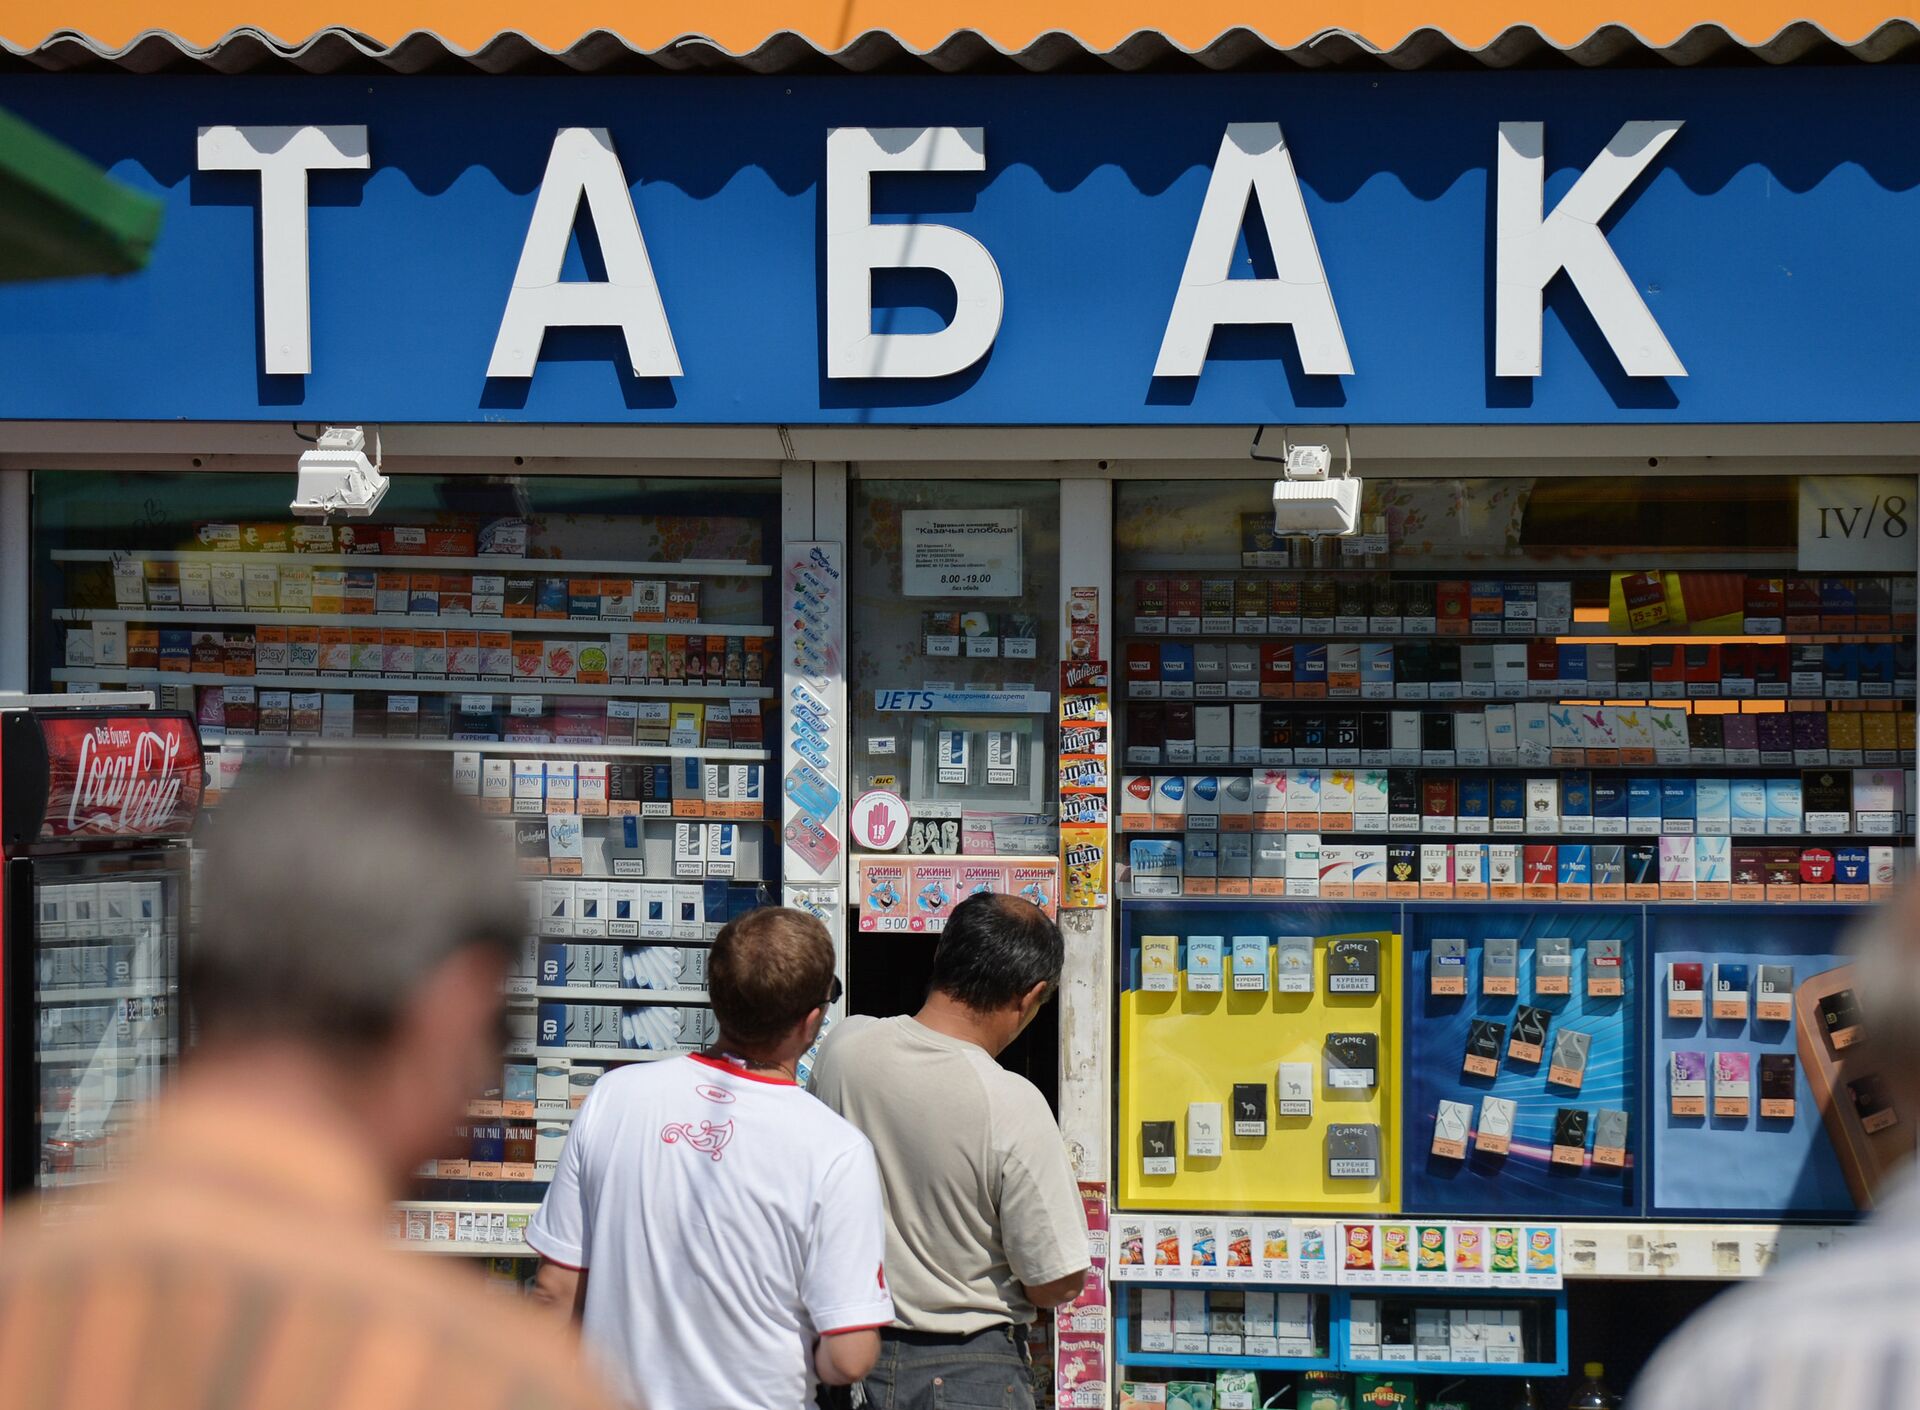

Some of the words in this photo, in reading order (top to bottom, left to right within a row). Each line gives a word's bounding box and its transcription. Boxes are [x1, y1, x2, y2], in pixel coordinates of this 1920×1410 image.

[196, 119, 1688, 381] ТАБАК
[1817, 495, 1908, 539] IV/8
[967, 526, 1017, 534] слобода"
[941, 575, 960, 583] 8.00
[670, 593, 695, 603] opal
[1633, 611, 1646, 622] 25
[1651, 606, 1663, 618] 39
[258, 648, 284, 663] play
[291, 649, 317, 663] play
[800, 691, 823, 712] Orbit
[877, 691, 937, 710] JETS
[800, 708, 822, 730] Orbit
[95, 727, 110, 744] Всё
[111, 727, 130, 748] будет
[800, 726, 823, 747] Orbit
[800, 743, 823, 765] Orbit
[990, 734, 999, 763] BOND
[456, 770, 476, 779] BOND
[802, 766, 825, 788] Orbit
[67, 731, 180, 831] Coca-Cola
[486, 777, 507, 787] BOND
[519, 777, 538, 786] BOND
[551, 777, 570, 787] BOND
[582, 779, 601, 788] BOND
[611, 766, 621, 796] BOND
[644, 766, 653, 796] BOND
[708, 767, 717, 796] BOND
[737, 767, 746, 796] BOND
[1131, 784, 1150, 792] Wings
[1024, 815, 1048, 825] JETS
[802, 817, 825, 839] Orbit
[872, 824, 885, 836] 18
[679, 825, 688, 853] BOND
[711, 825, 720, 853] BOND
[1638, 852, 1652, 860] More
[1673, 855, 1689, 863] More
[1709, 855, 1725, 863] More
[867, 867, 902, 877] ДЖИНН
[1535, 862, 1552, 870] More
[1569, 862, 1586, 871] More
[1604, 863, 1620, 872] More
[916, 867, 951, 878] ДЖИНН
[965, 867, 1000, 878] ДЖИНН
[1144, 943, 1170, 951] CAMEL
[1336, 943, 1368, 952] CAMEL
[544, 960, 558, 973] 6
[543, 1020, 557, 1033] 6
[1335, 1036, 1368, 1046] CAMEL
[474, 1127, 485, 1138] PALL
[487, 1127, 500, 1139] MALL
[506, 1129, 518, 1139] PALL
[520, 1129, 533, 1140] MALL
[1336, 1127, 1368, 1137] CAMEL
[1227, 1381, 1246, 1392] Сад
[1362, 1391, 1407, 1403] ПРИВЕТ
